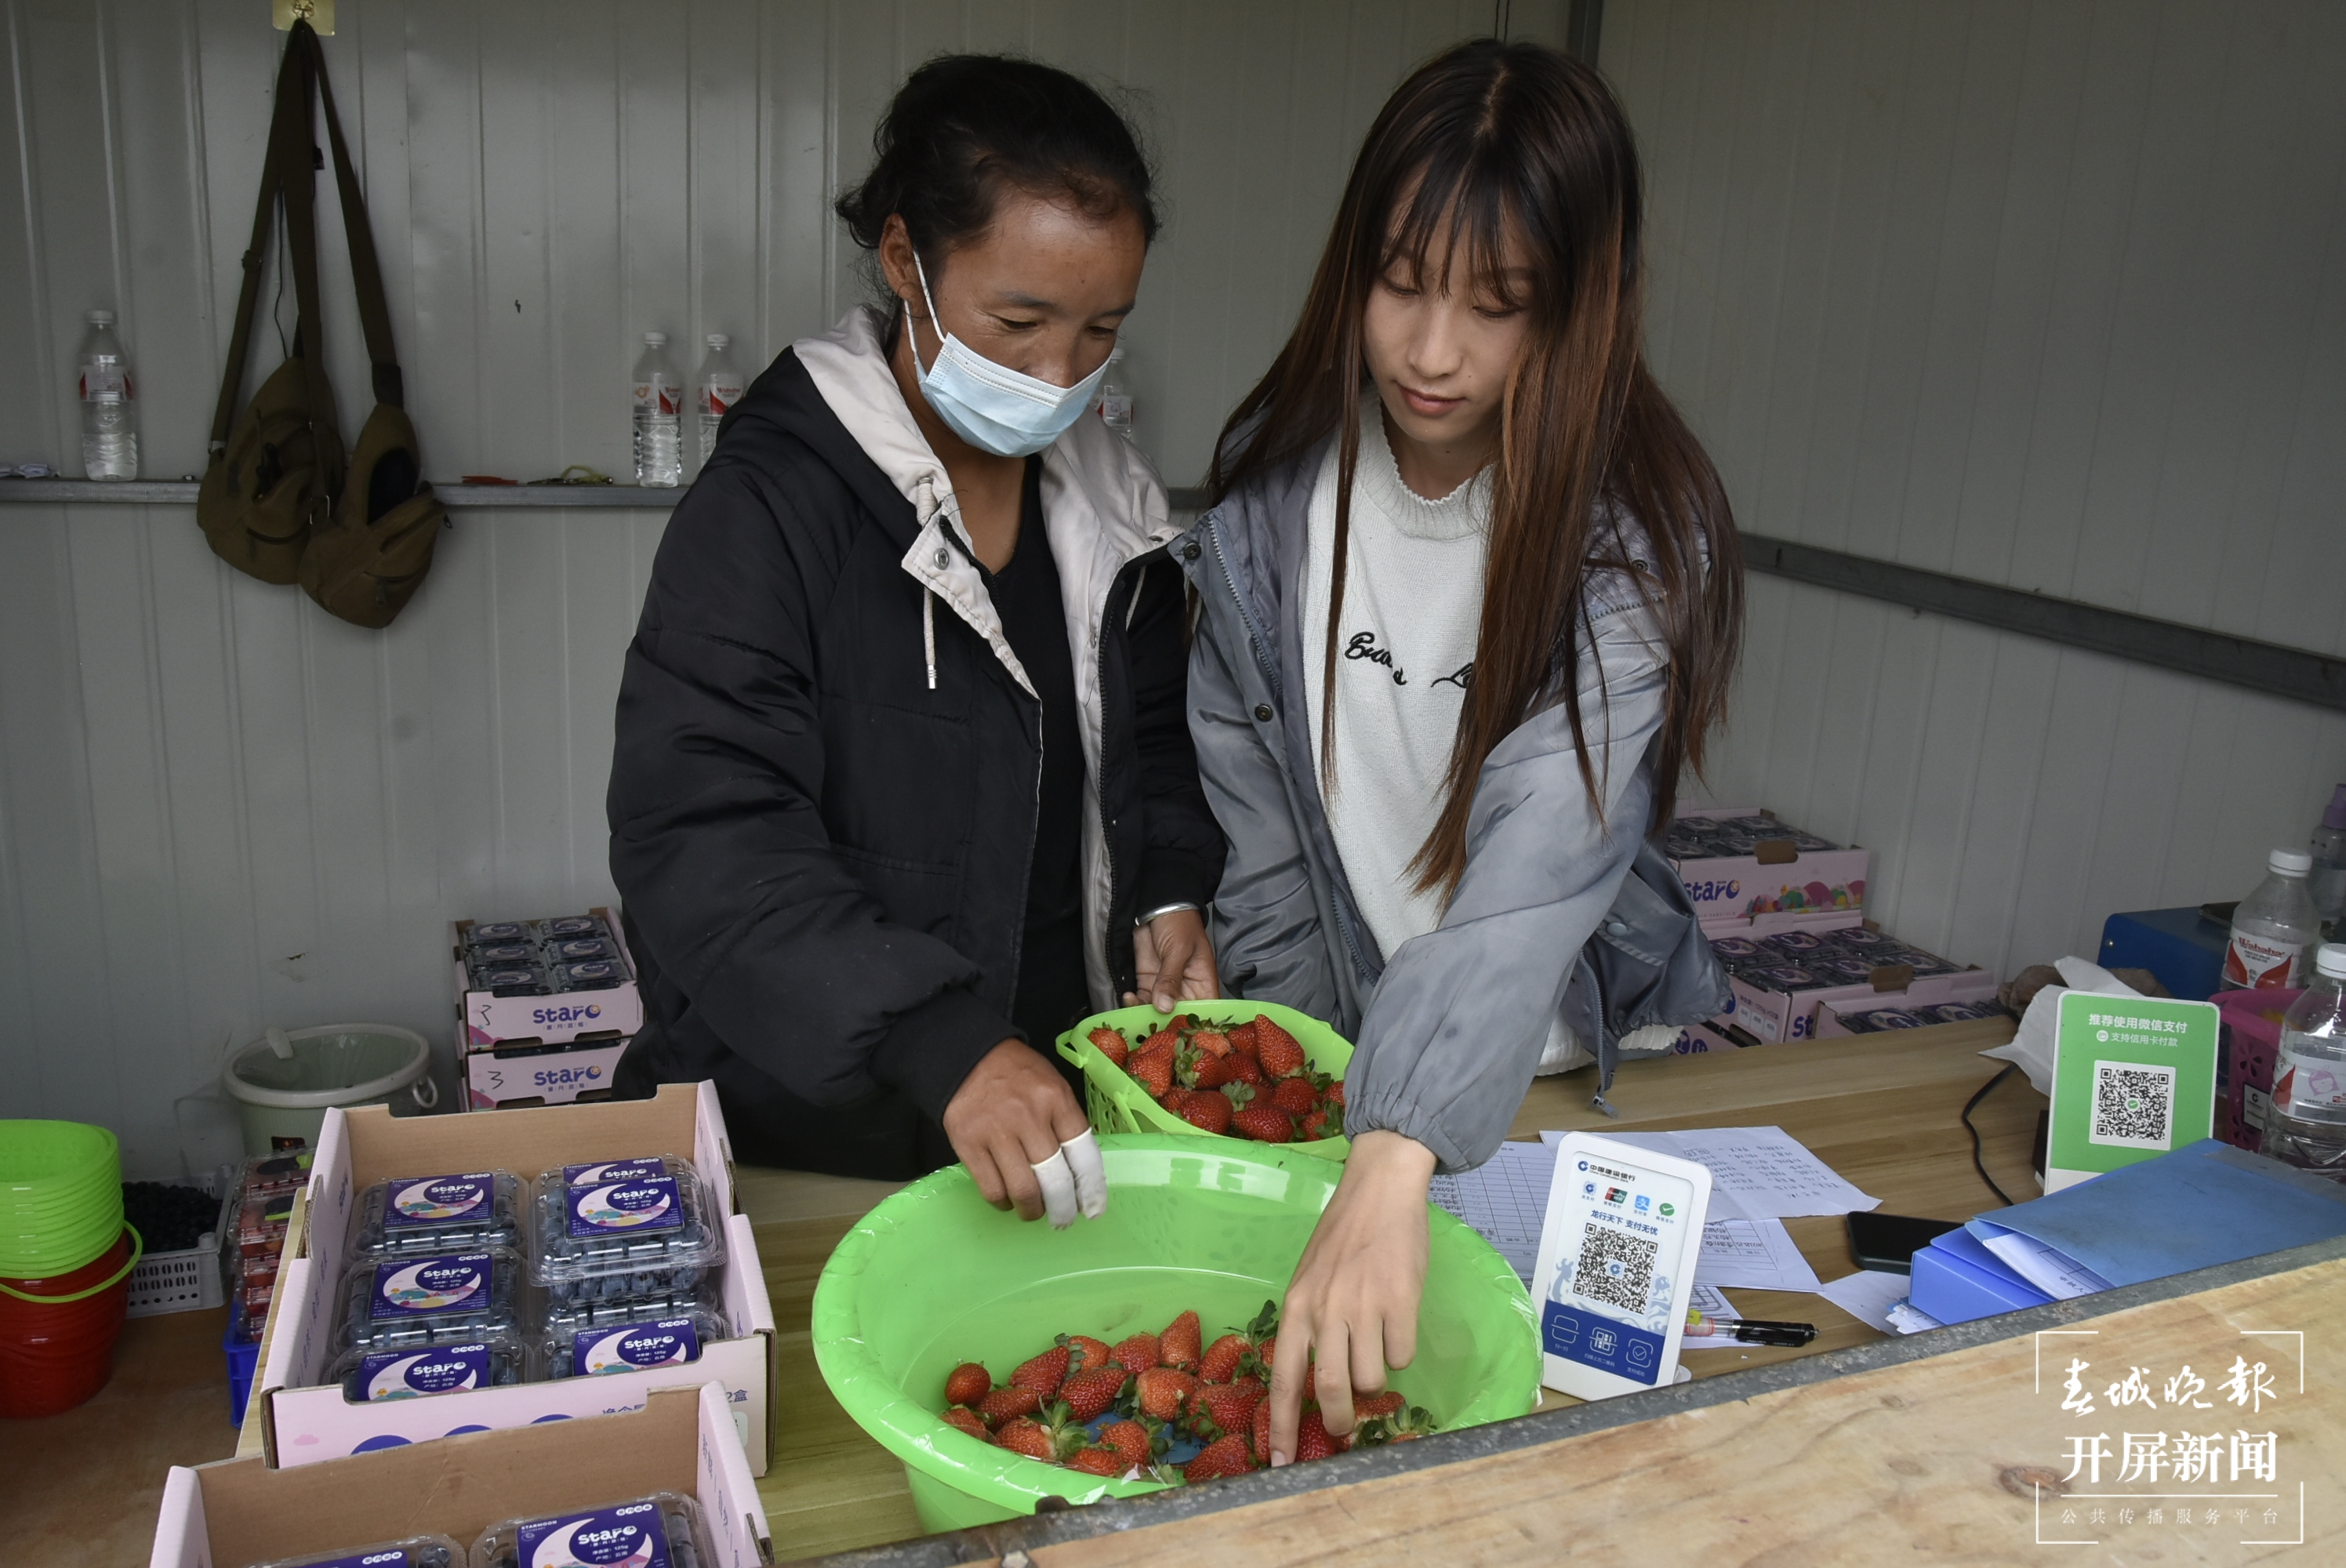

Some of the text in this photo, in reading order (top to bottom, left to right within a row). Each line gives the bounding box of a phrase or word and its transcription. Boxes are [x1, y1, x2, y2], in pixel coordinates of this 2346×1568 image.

[2089, 1013, 2188, 1034] 推荐使用微信支付
[2111, 1033, 2178, 1047] 支持信用卡付款
[487, 1071, 504, 1089] 3
[1590, 1164, 1636, 1181] 中国建设银行
[1591, 1209, 1658, 1236] 龙行天下 支付无忧
[1655, 1215, 1675, 1225] 微信支付
[1626, 1367, 1646, 1377] 支付成功
[521, 1519, 557, 1530] STARMOON
